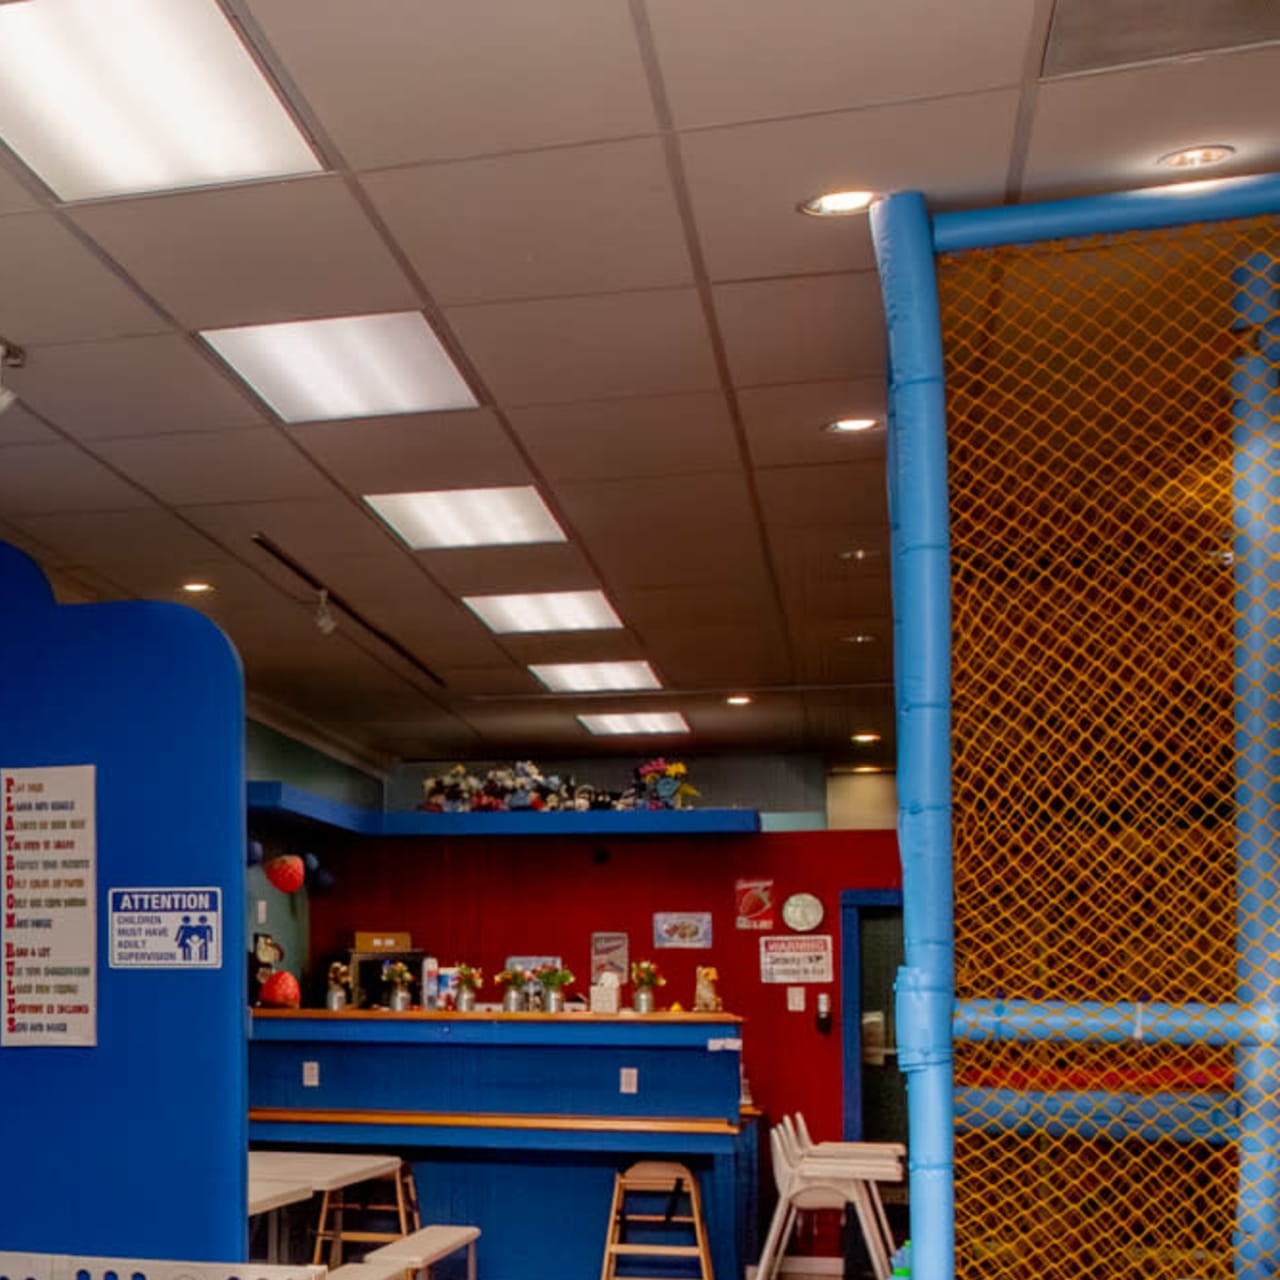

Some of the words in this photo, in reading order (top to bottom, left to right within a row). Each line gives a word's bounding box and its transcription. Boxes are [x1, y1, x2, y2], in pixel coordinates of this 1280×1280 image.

[120, 893, 210, 910] ATTENTION
[117, 915, 162, 926] CHILDREN
[117, 927, 143, 938] MUST
[145, 927, 169, 938] HAVE
[117, 938, 147, 950] ADULT
[117, 951, 177, 962] SUPERVISION
